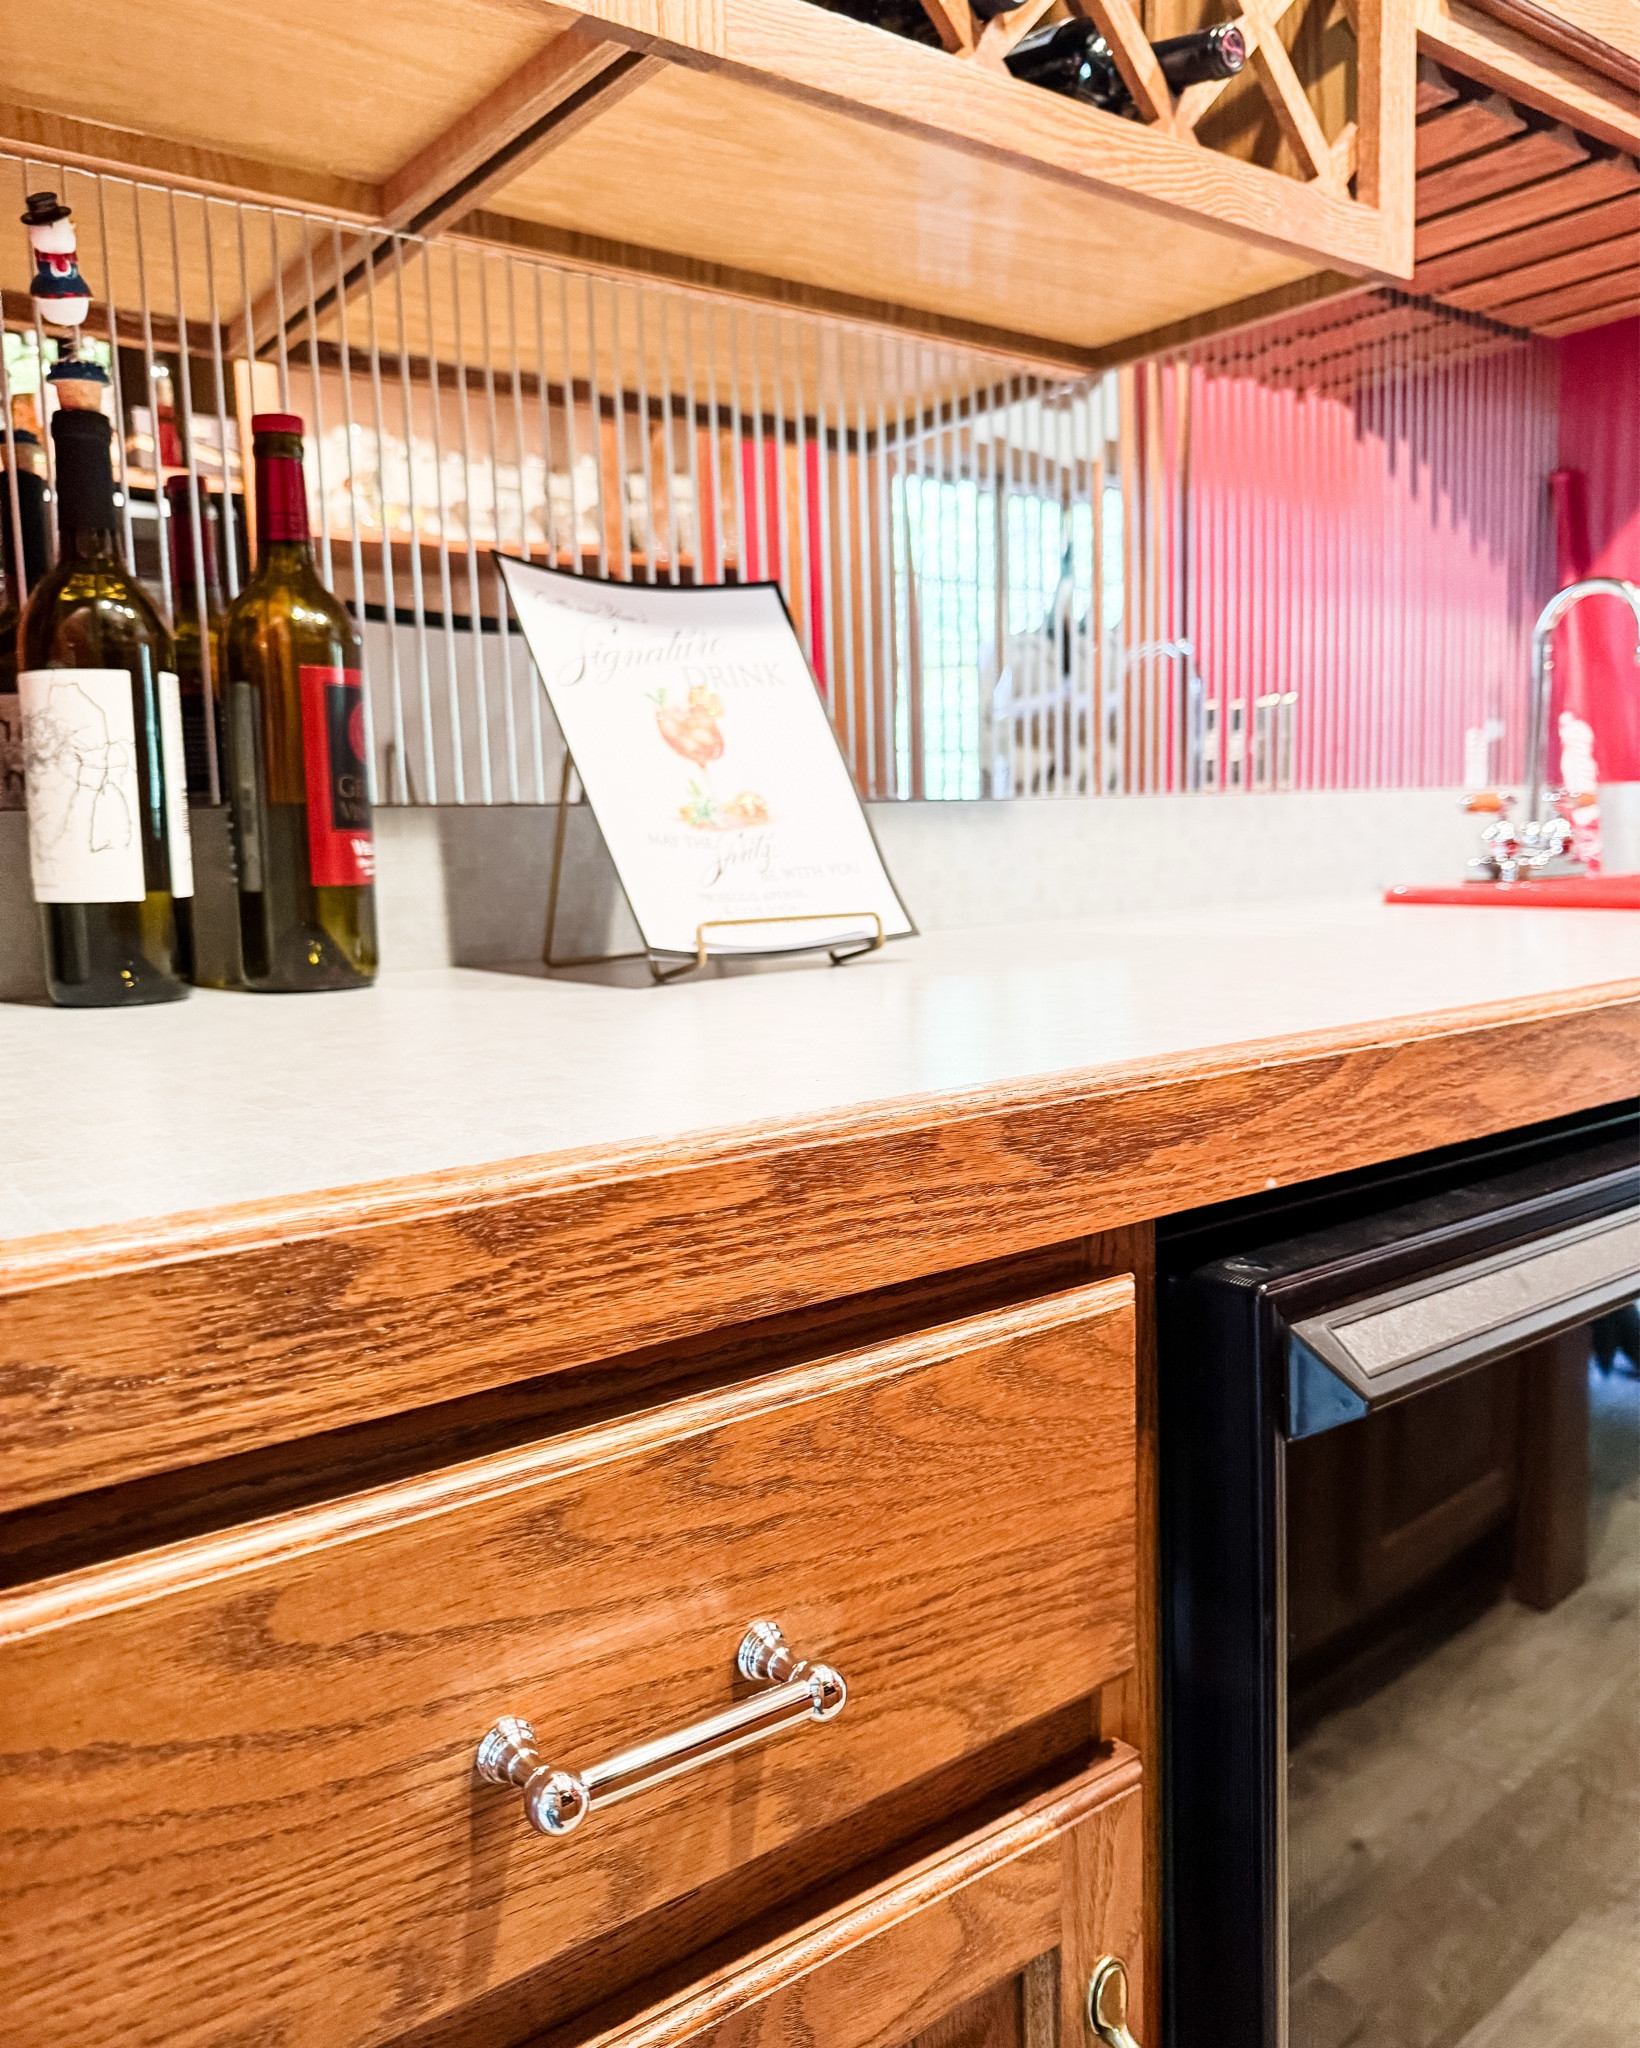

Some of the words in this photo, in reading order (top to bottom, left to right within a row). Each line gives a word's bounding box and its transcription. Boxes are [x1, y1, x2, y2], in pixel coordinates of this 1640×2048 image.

[558, 620, 726, 687] Signature
[681, 662, 788, 689] DRINK
[781, 865, 826, 880] WITH
